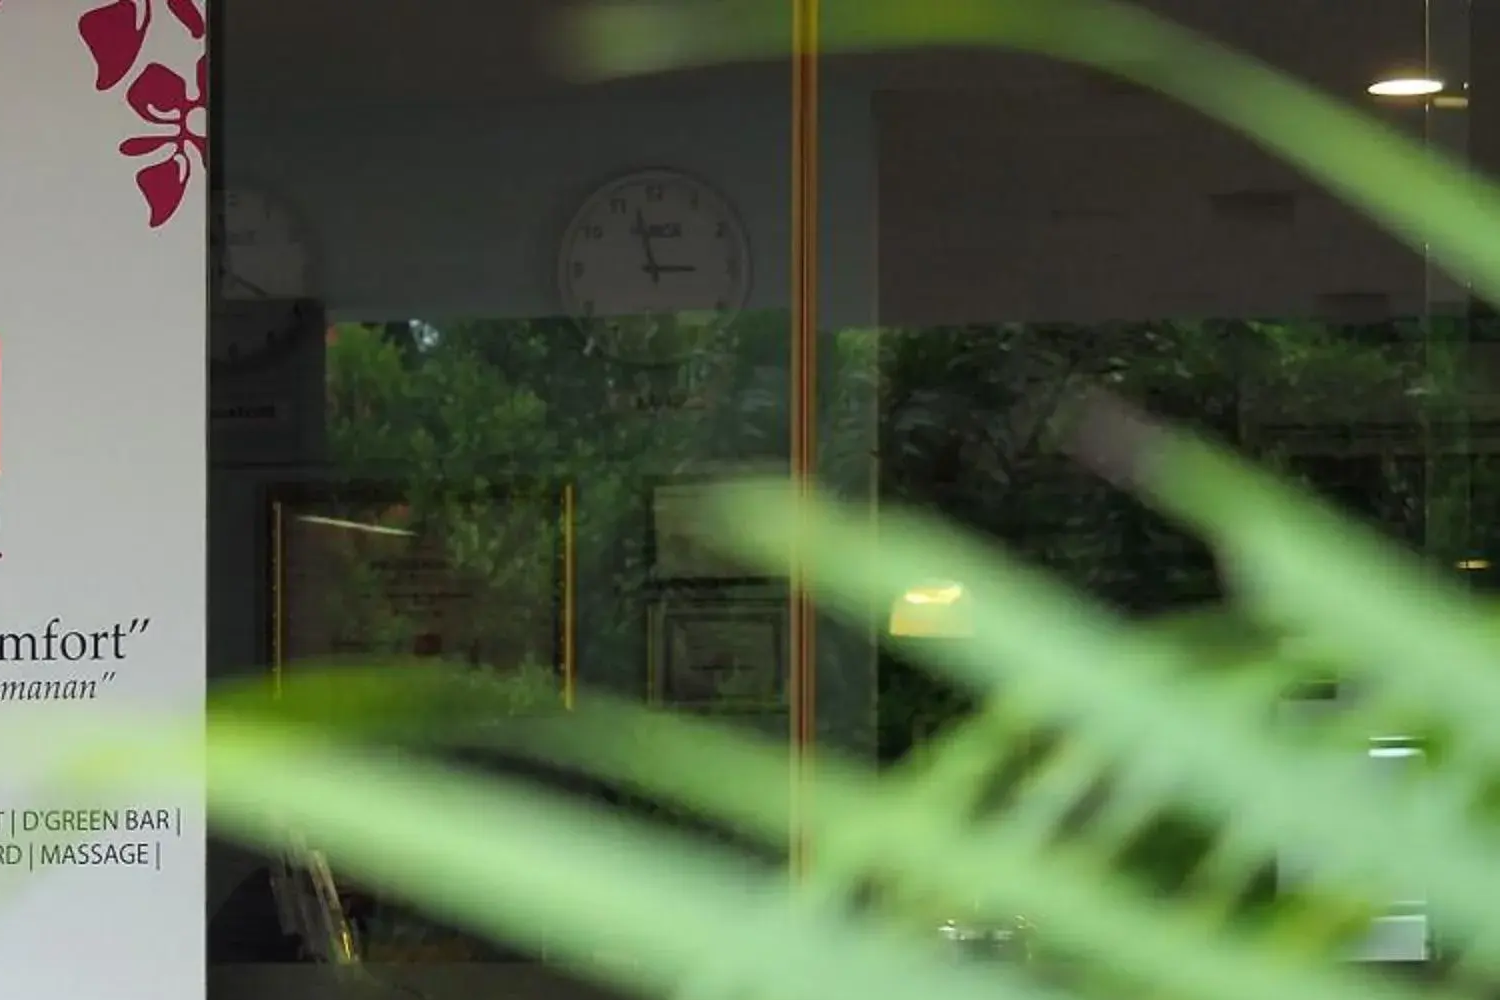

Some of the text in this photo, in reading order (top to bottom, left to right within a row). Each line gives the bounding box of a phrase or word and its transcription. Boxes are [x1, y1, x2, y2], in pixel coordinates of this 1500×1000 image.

[23, 810, 118, 831] D'GREEN
[125, 809, 170, 833] BAR
[41, 842, 148, 865] MASSAGE
